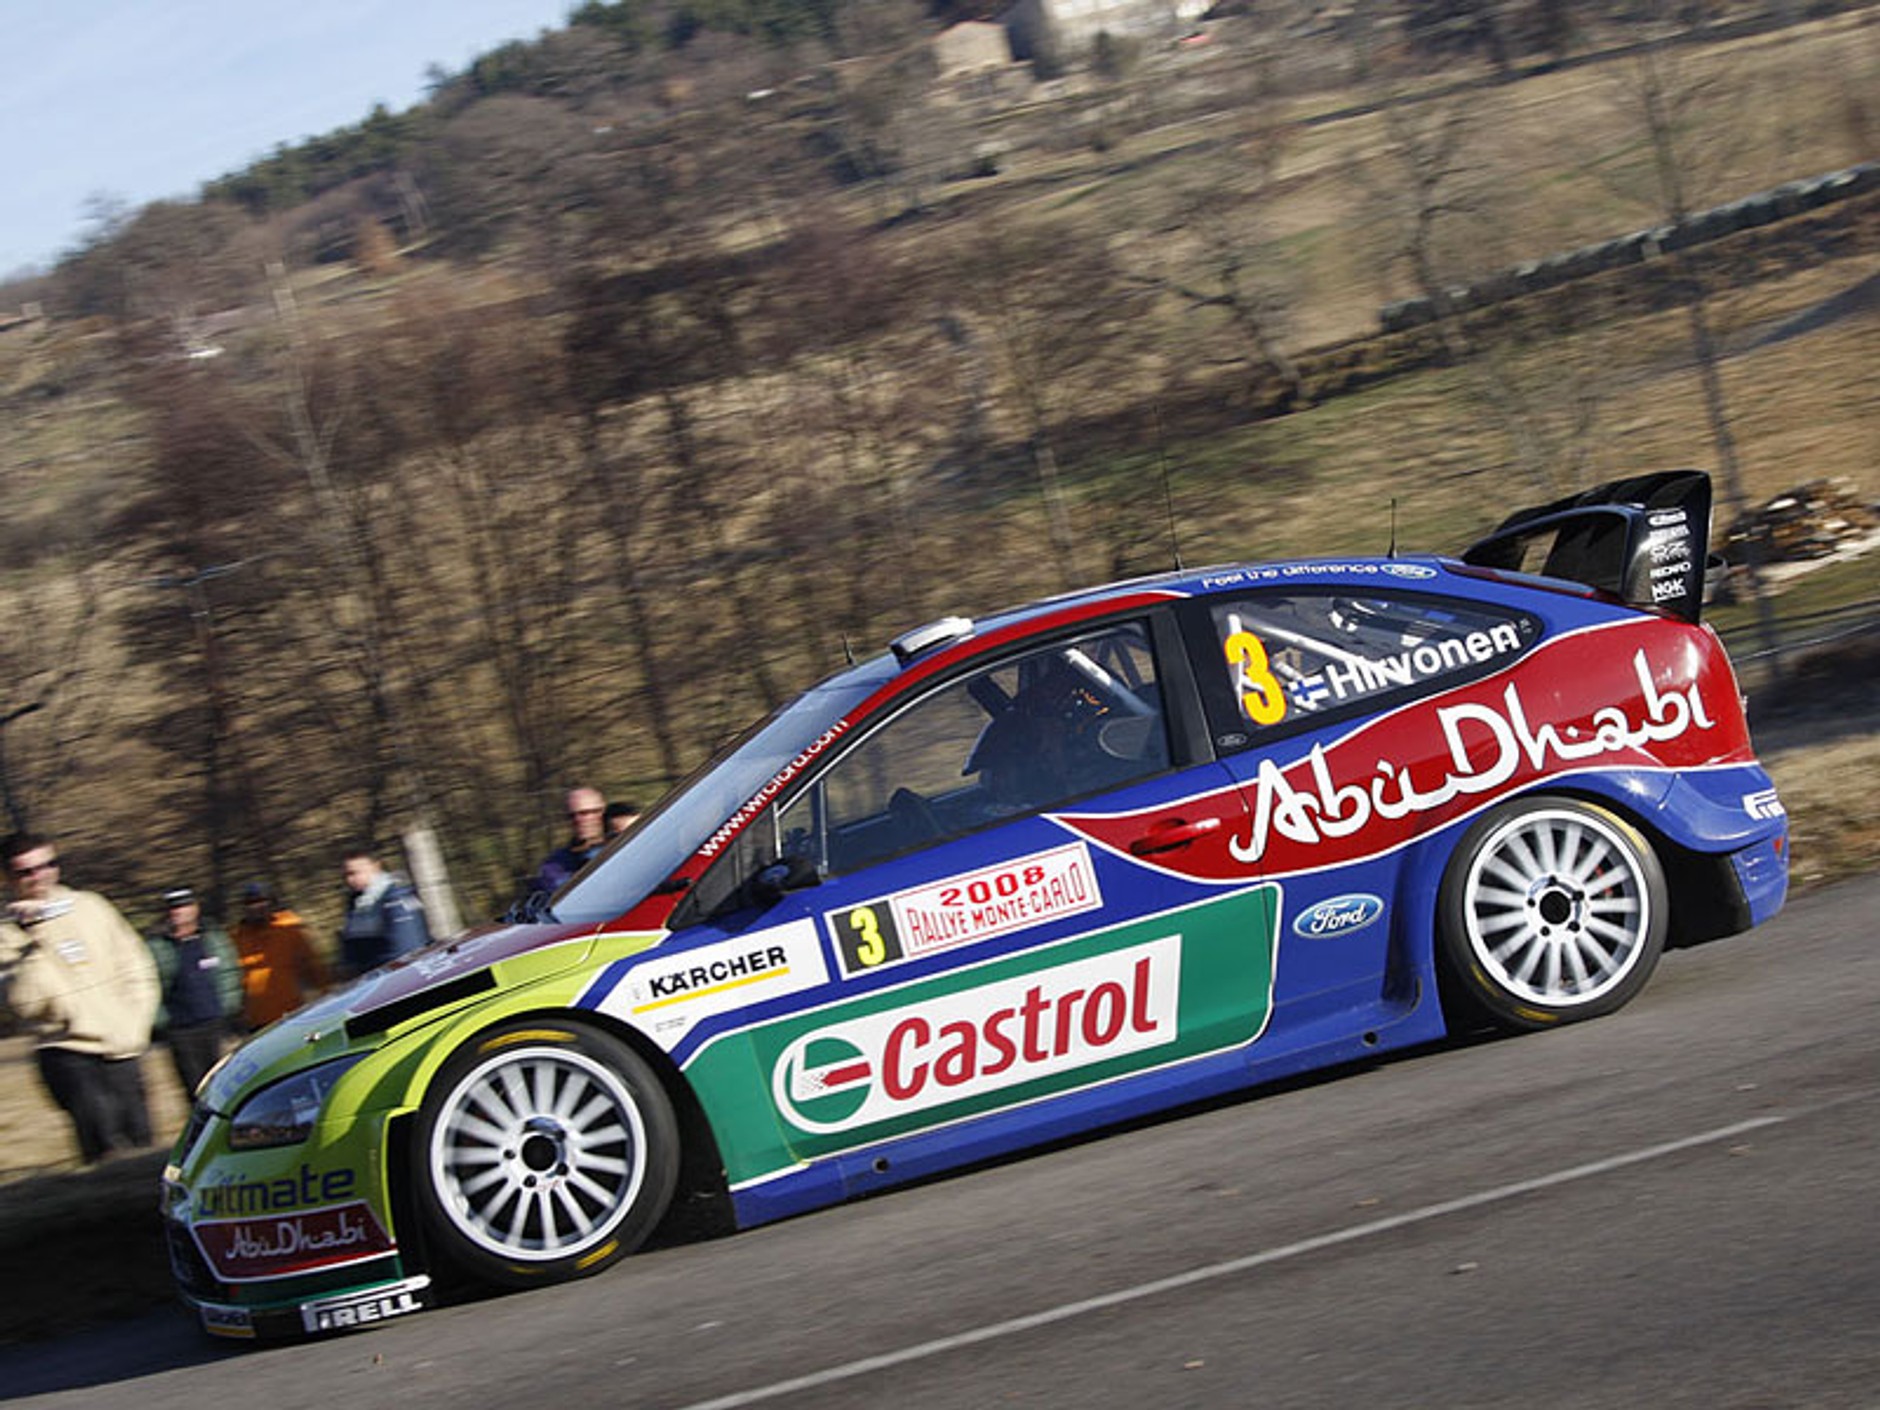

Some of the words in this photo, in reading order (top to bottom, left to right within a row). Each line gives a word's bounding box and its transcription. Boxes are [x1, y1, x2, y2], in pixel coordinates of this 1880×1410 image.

[1224, 631, 1287, 726] 3
[1437, 648, 1715, 795] Dhabi
[906, 908, 968, 948] RALLYE
[971, 862, 1087, 932] MONTE-CARLO
[939, 865, 1045, 906] 2008
[850, 906, 887, 966] 3
[1311, 902, 1367, 934] Ford
[649, 946, 787, 998] KÄRCHER
[882, 956, 1158, 1101] Castrol
[198, 1163, 355, 1215] ultimate
